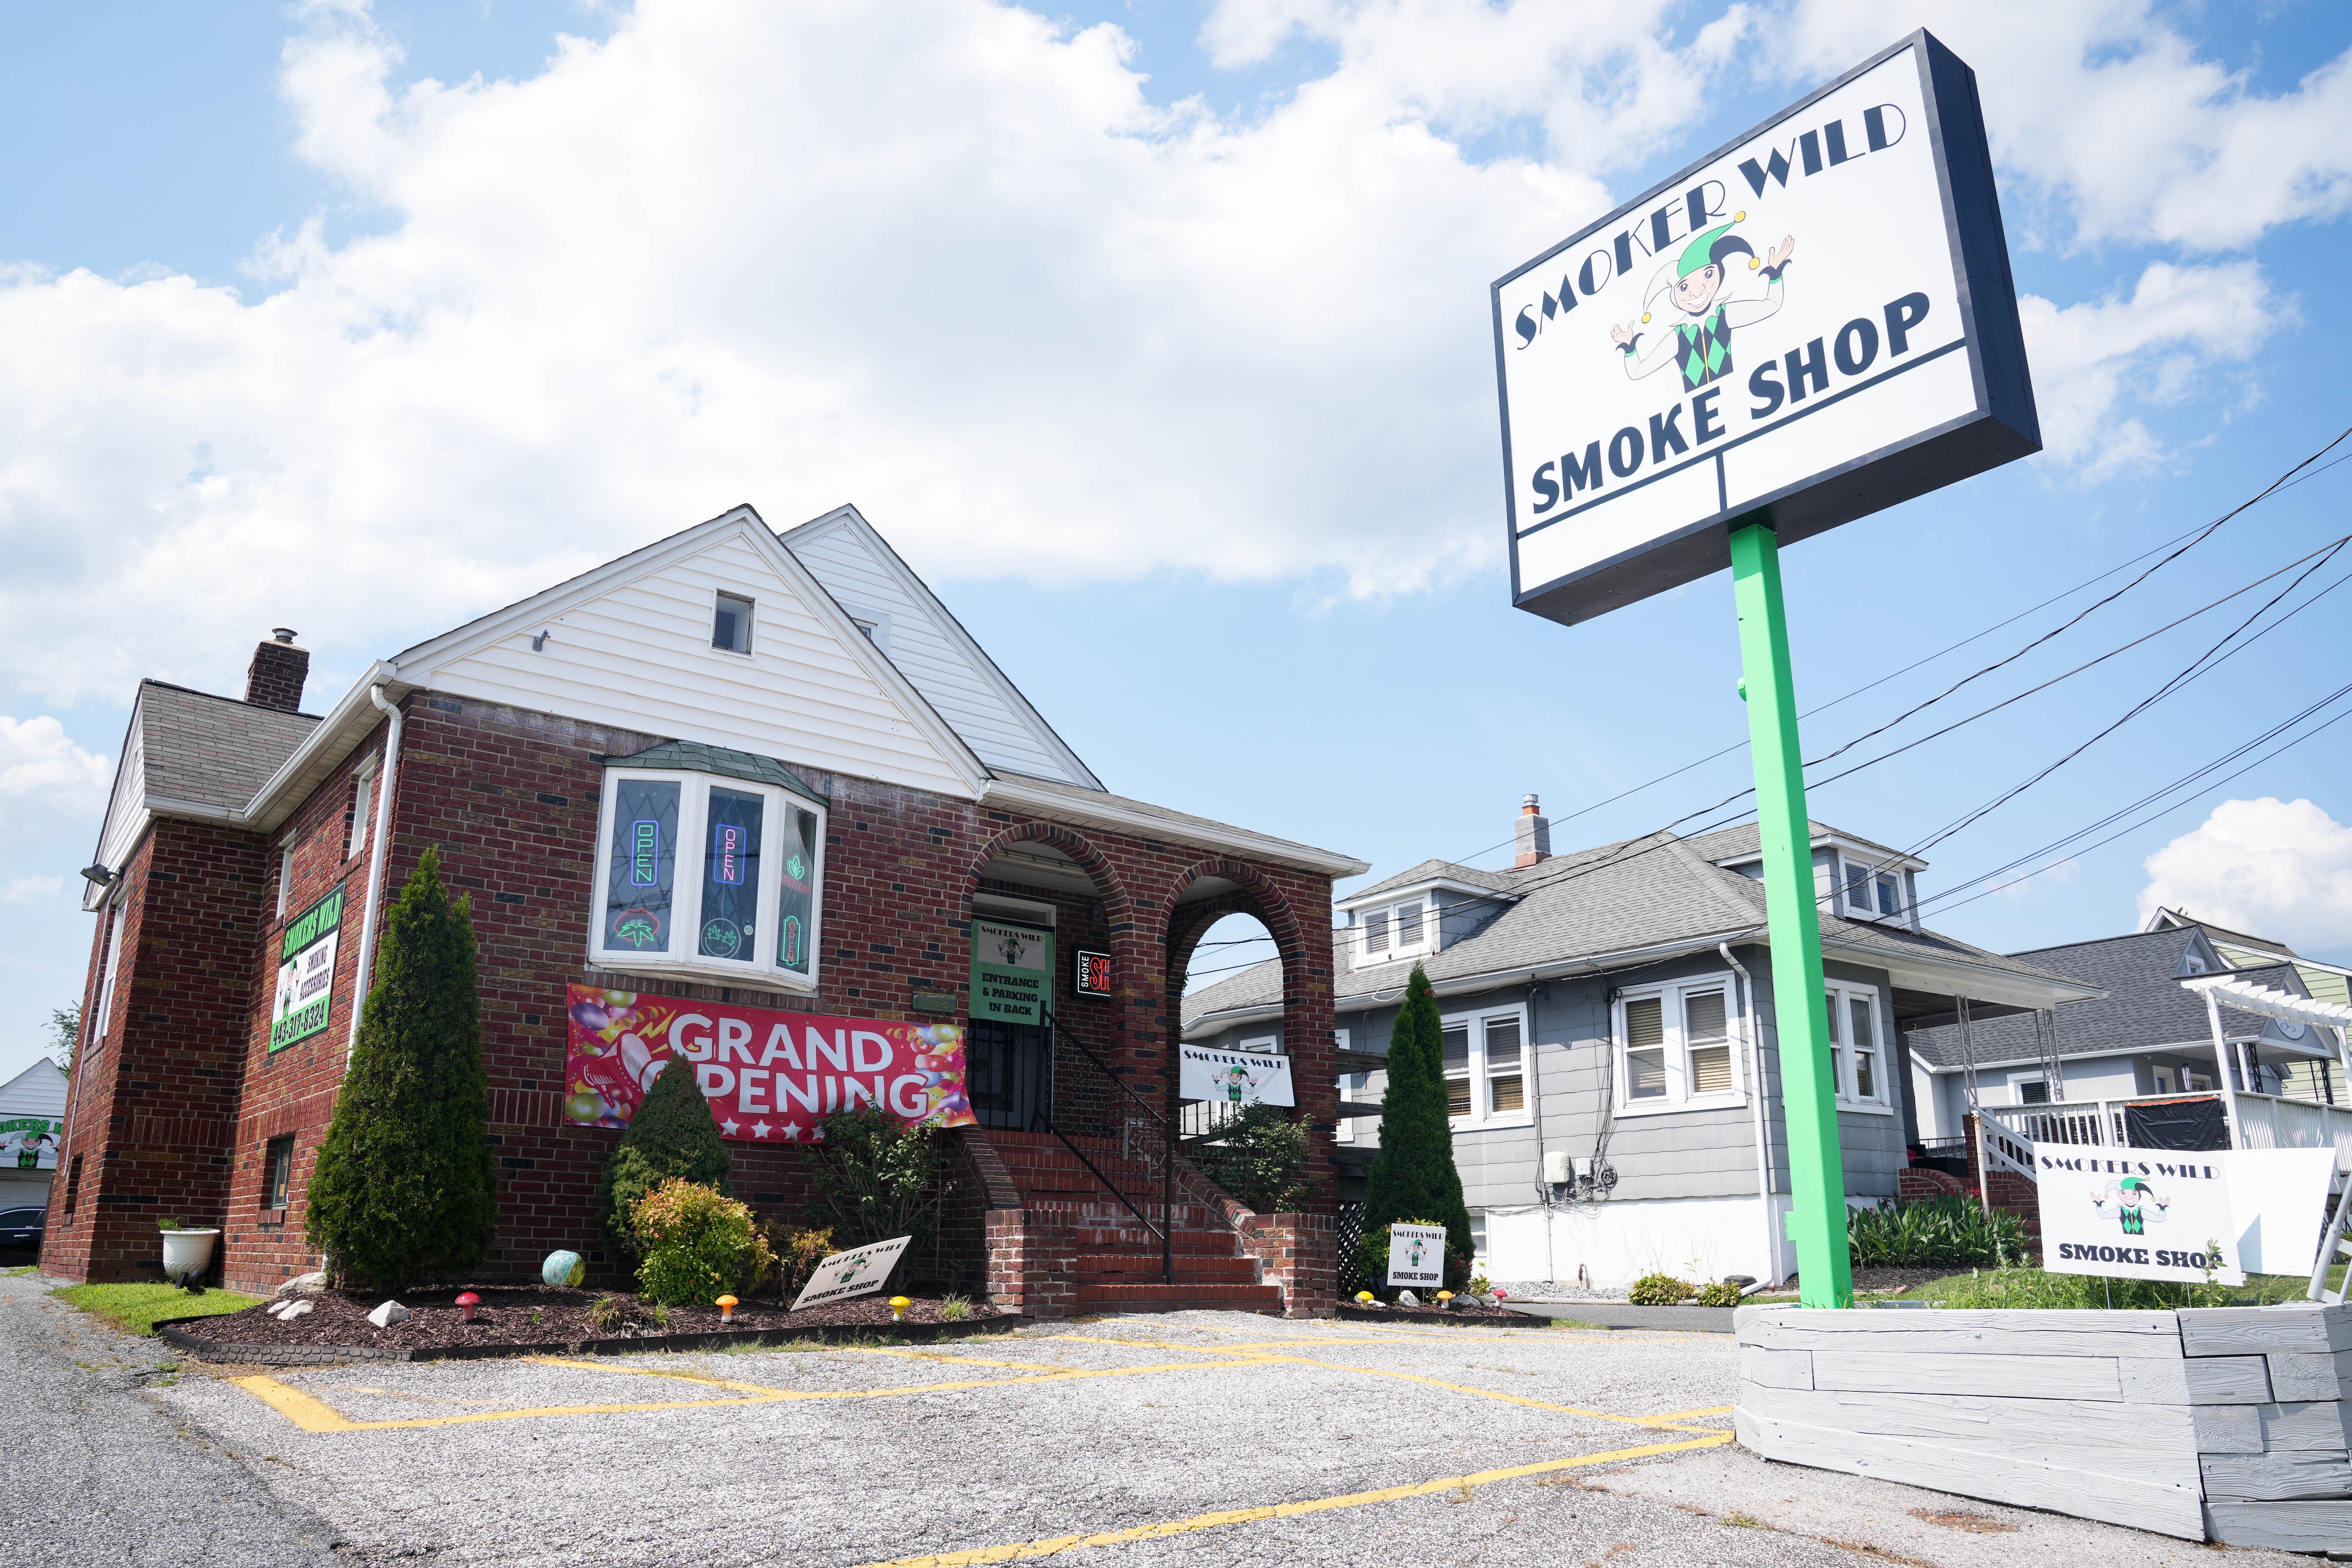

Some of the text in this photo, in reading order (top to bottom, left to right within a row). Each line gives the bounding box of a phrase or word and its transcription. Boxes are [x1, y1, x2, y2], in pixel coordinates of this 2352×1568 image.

[1515, 103, 1906, 350] SMOKER WILD
[1532, 292, 1930, 514] SMOKE SHOP
[636, 825, 653, 882] OPEN
[724, 829, 736, 881] OPEN
[283, 892, 342, 959] SMOKERS WILD
[981, 926, 1042, 942] SMOKERS WILD
[787, 921, 796, 963] OPEN
[307, 944, 328, 973] SMOKING
[299, 967, 330, 1001] ACCESSORIES
[982, 973, 1038, 989] ENTRANCE
[983, 987, 1038, 1003] & PARKING
[989, 1002, 1032, 1016] IN BACK
[273, 1000, 325, 1047] 443-317-8324
[669, 1013, 893, 1072] GRAND
[1184, 1050, 1285, 1069] SMOKERS WILD
[2041, 1156, 2219, 1179] SMOKERS WILD
[820, 1243, 905, 1269] SMOKERS WILD
[2059, 1243, 2222, 1270] SMOKE SHOP
[1393, 1272, 1418, 1280] SMOKE
[802, 1280, 879, 1303] SMOKE SHOP
